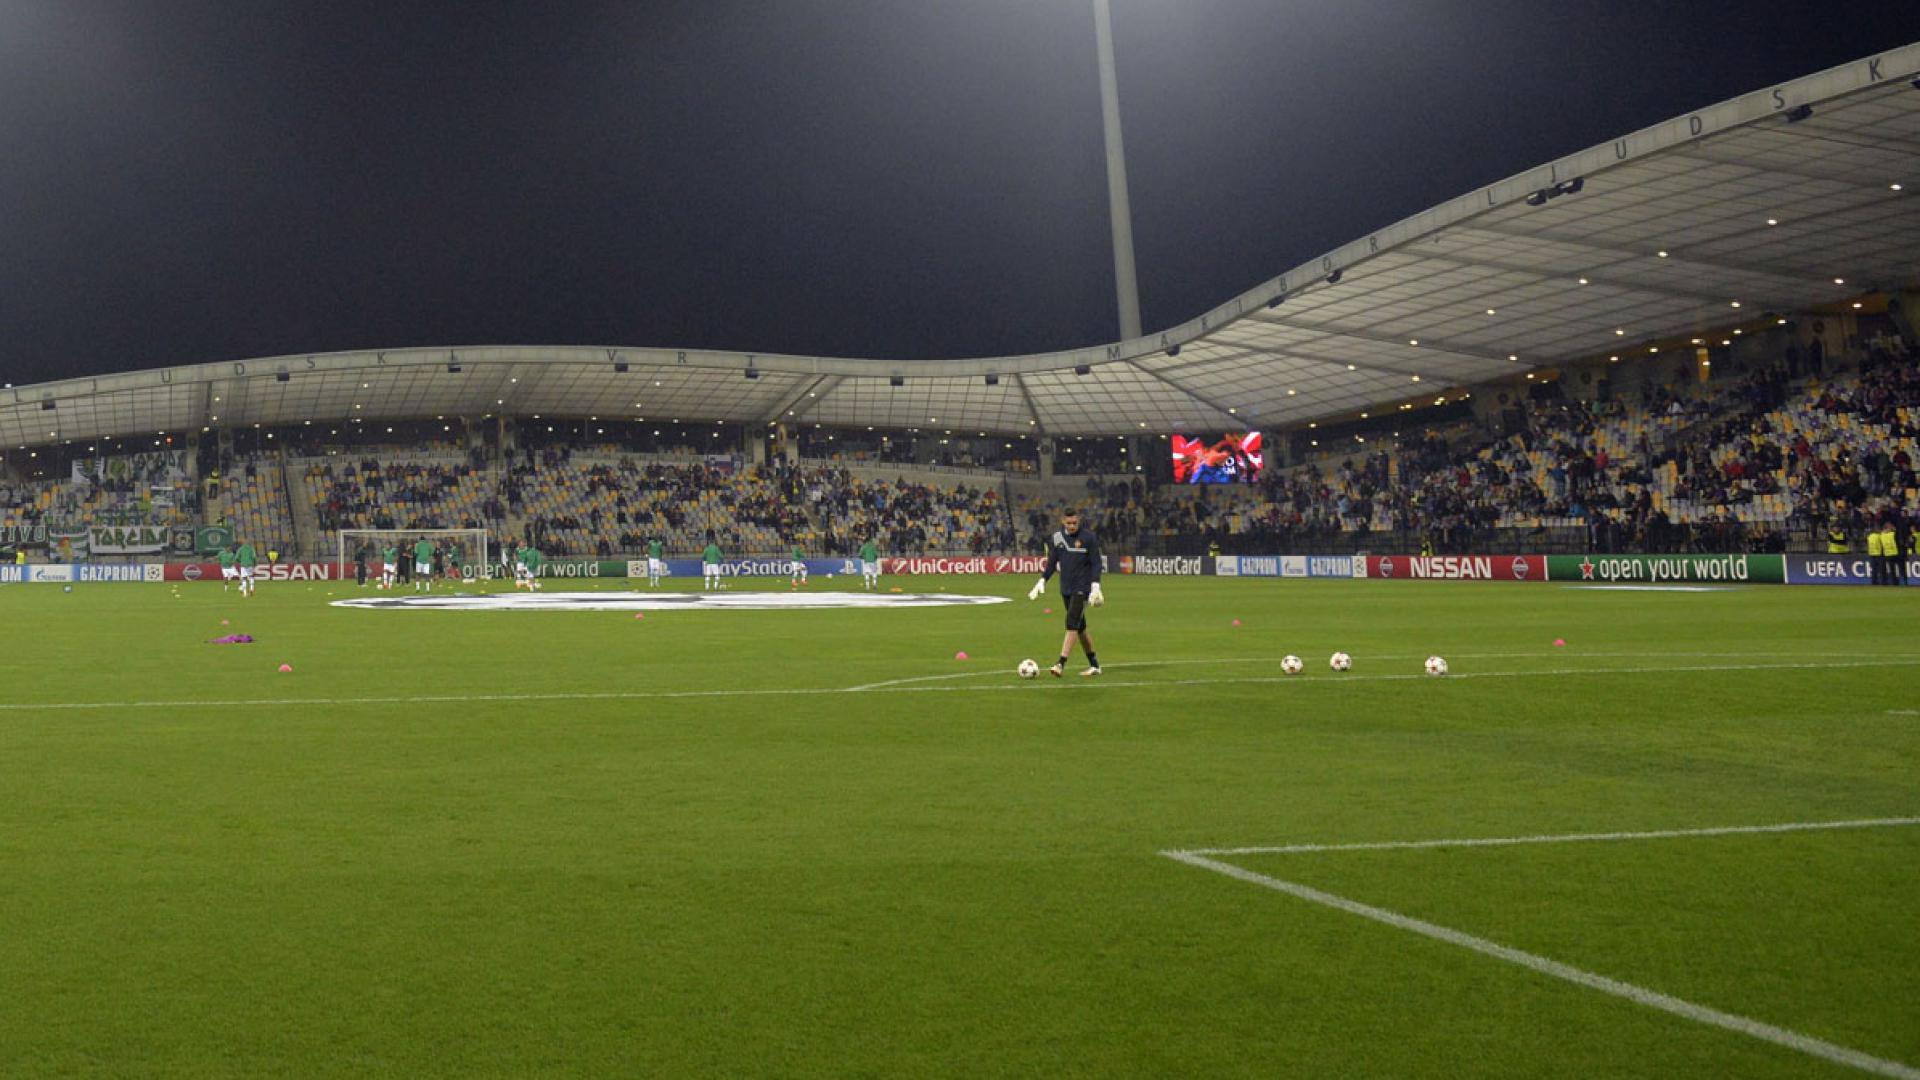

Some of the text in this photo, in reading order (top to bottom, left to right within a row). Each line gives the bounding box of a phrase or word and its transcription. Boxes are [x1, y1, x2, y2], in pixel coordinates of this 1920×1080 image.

[80, 565, 142, 581] GAZPROM
[553, 561, 599, 577] world
[911, 558, 986, 574] UniCredit
[1136, 556, 1201, 575] MasterCard
[1409, 557, 1492, 578] NISSAN
[1599, 554, 1748, 582] open your world
[1805, 560, 1847, 577] UEFA
